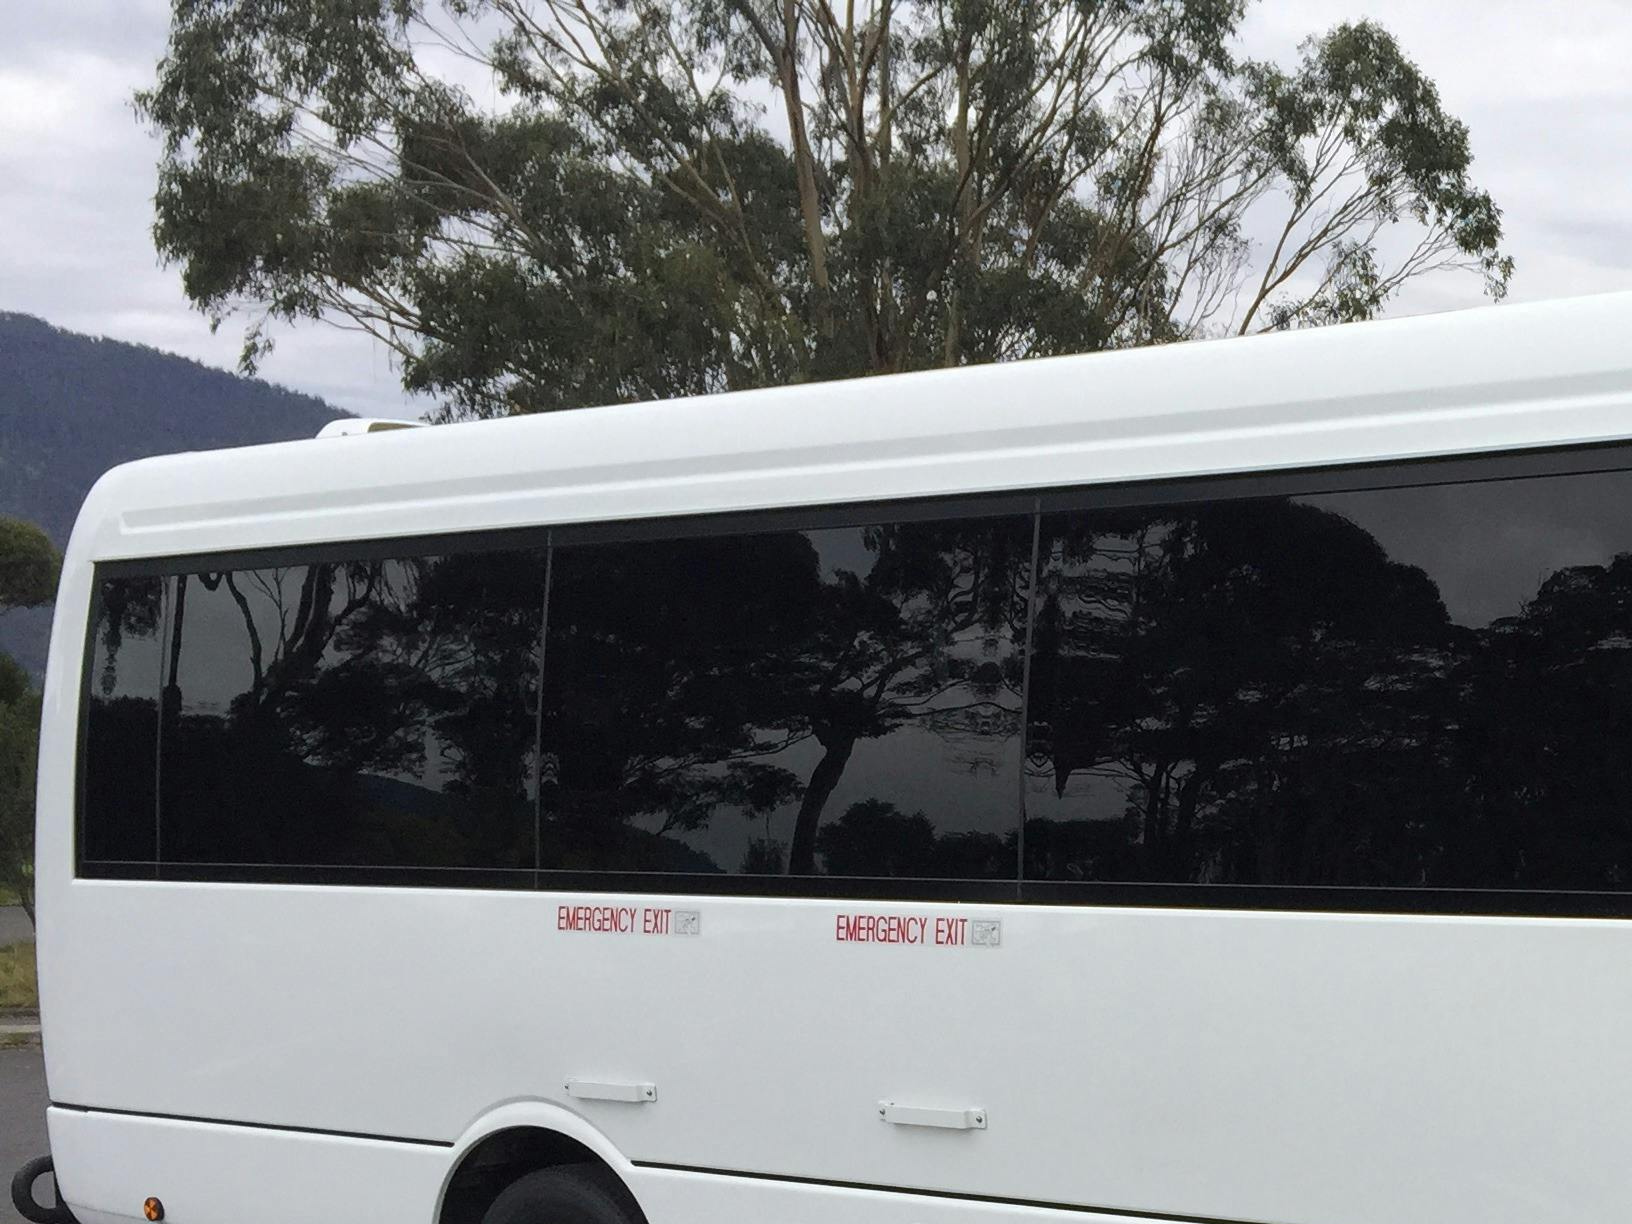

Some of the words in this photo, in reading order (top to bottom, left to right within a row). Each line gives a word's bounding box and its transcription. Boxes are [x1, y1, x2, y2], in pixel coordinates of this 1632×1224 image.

[557, 906, 637, 933] EMERGENCY
[643, 909, 671, 935] EXIT
[836, 915, 927, 943] EMERGENCY
[935, 917, 968, 945] EXIT
